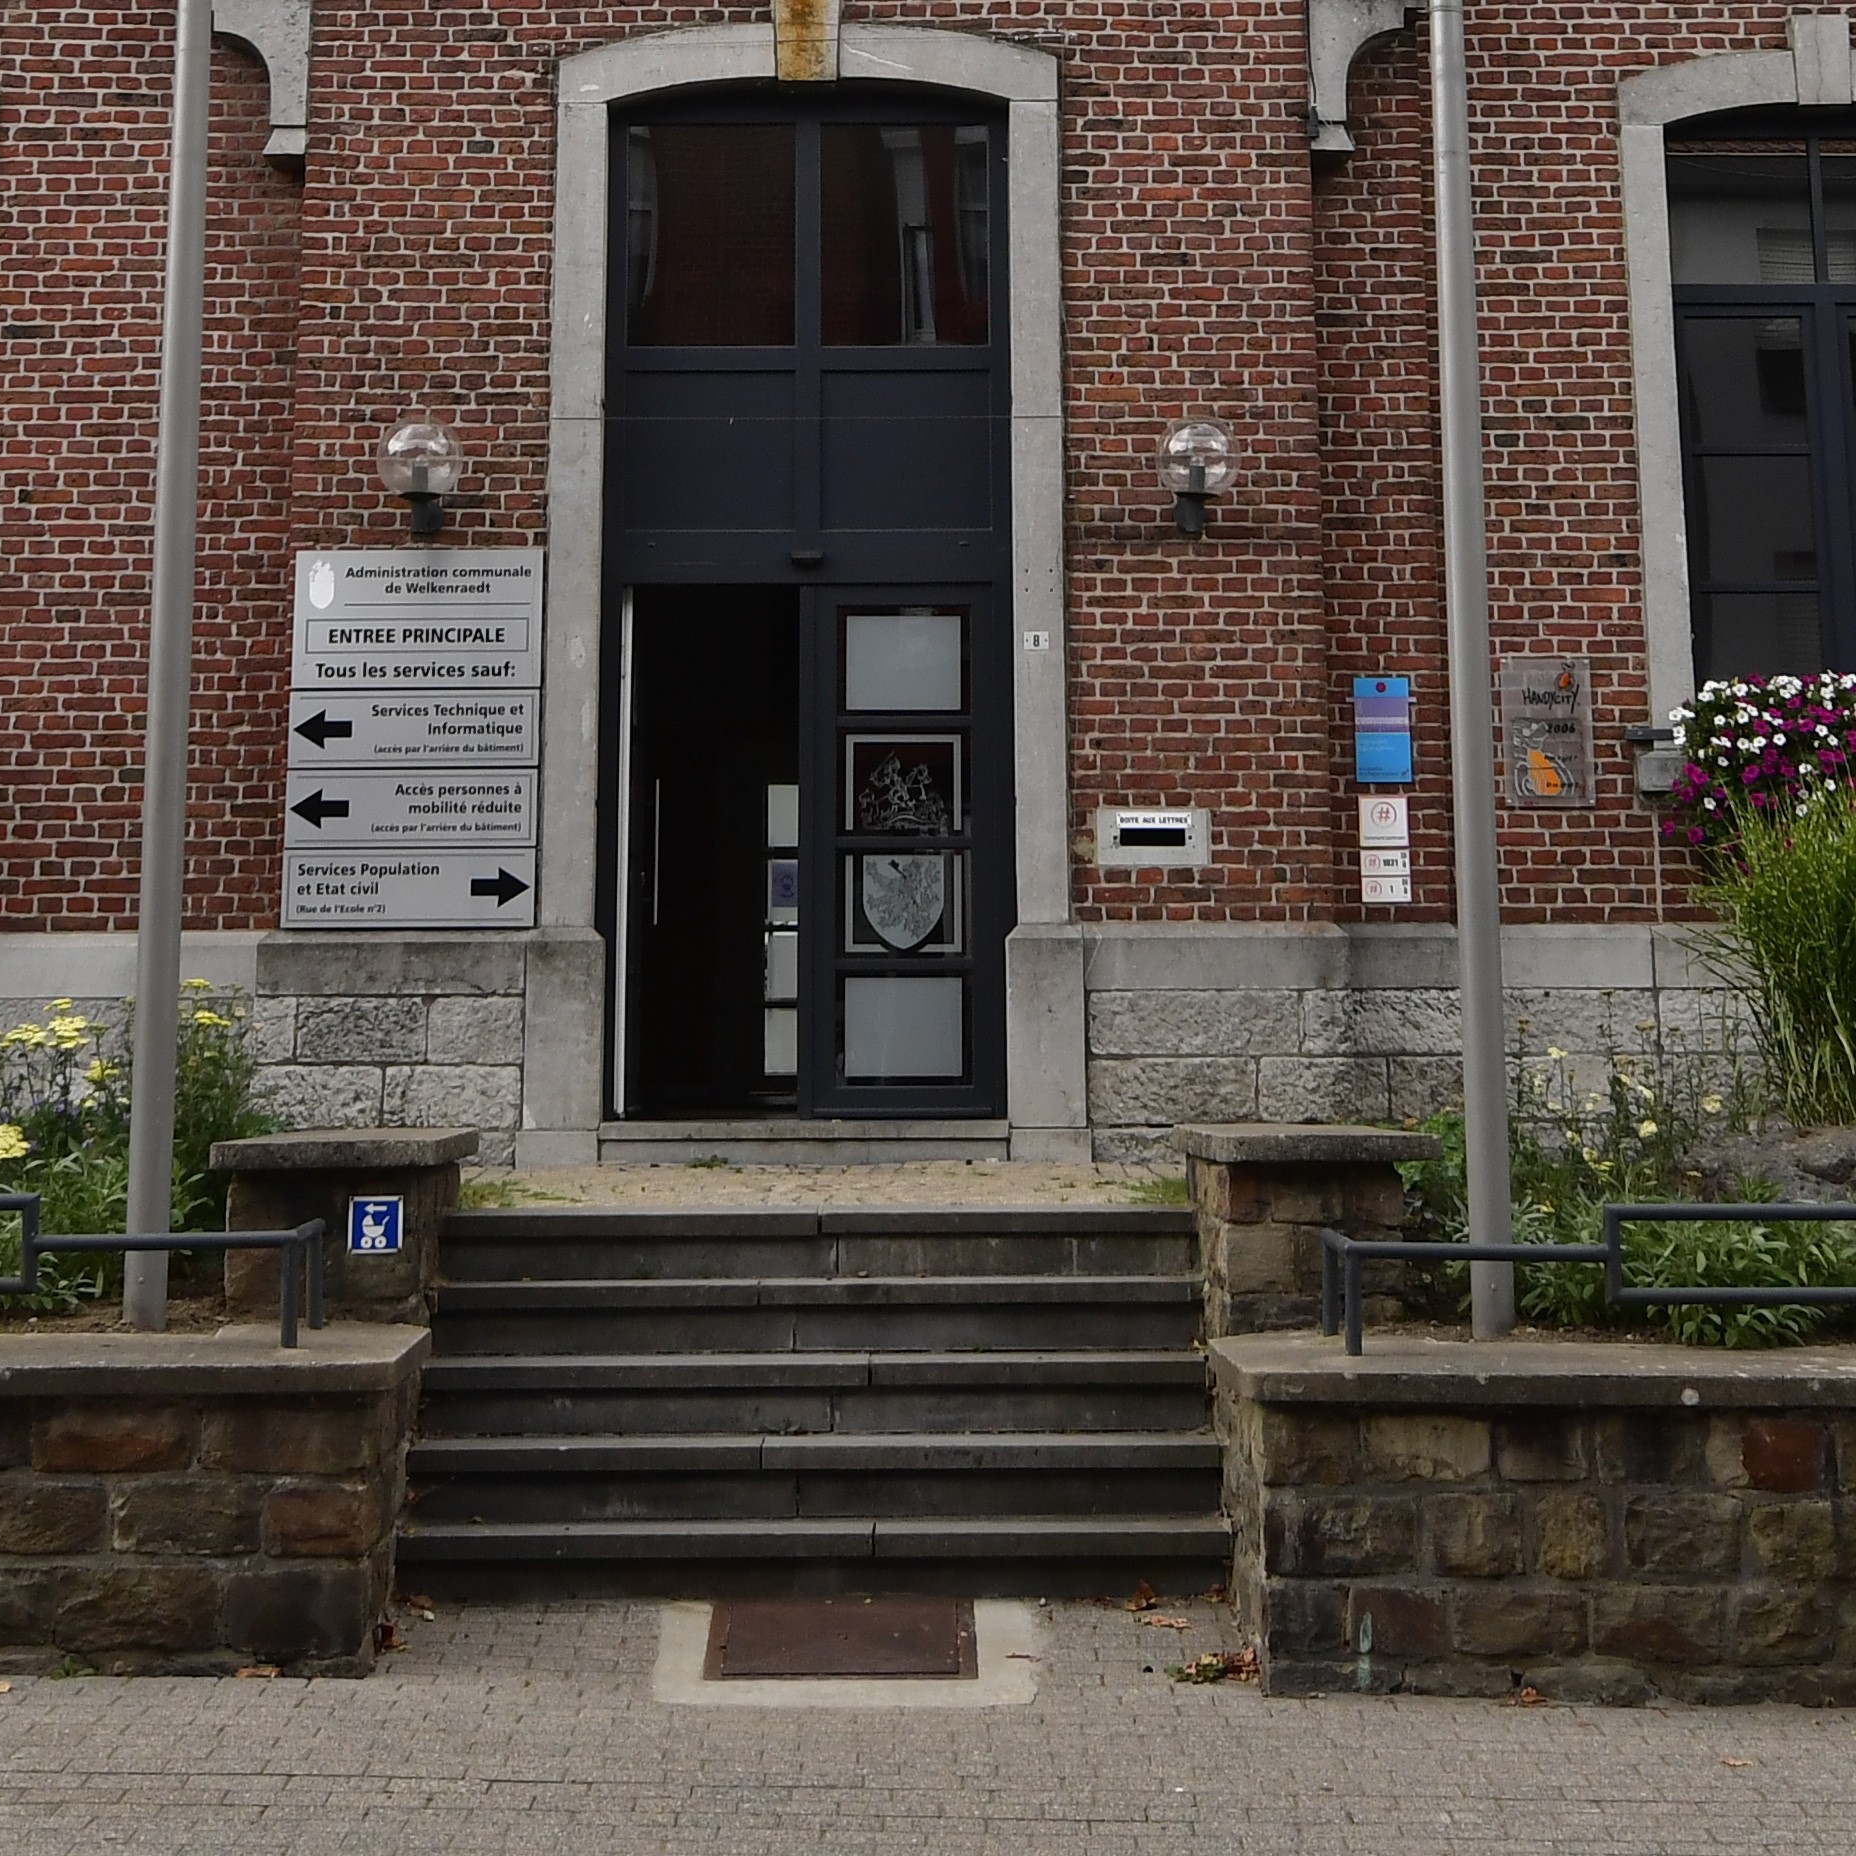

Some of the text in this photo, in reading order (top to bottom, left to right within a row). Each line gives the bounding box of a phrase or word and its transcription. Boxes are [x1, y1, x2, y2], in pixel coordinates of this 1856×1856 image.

[345, 565, 532, 579] Administration communale
[385, 581, 491, 594] de Welkenraedt
[328, 627, 506, 644] ENTREE PRINCIPALE
[1033, 634, 1040, 647] 8
[315, 660, 516, 678] Tous les services sauf:
[371, 702, 524, 719] Services Technique et
[428, 721, 523, 738] Informatique
[405, 745, 420, 755] par
[462, 743, 475, 753] du
[477, 742, 524, 753] bâtiment)
[394, 781, 522, 799] Accès personnes à
[408, 800, 522, 814] mobilité réduite
[1142, 816, 1156, 824] AUX
[1159, 816, 1188, 824] LETTRES
[402, 824, 417, 834] par
[459, 822, 472, 832] du
[475, 822, 522, 832] bâtiment)
[297, 862, 440, 879] Services Population
[297, 881, 379, 895] et Etat civil
[296, 904, 317, 914] (Rue
[319, 904, 332, 914] de
